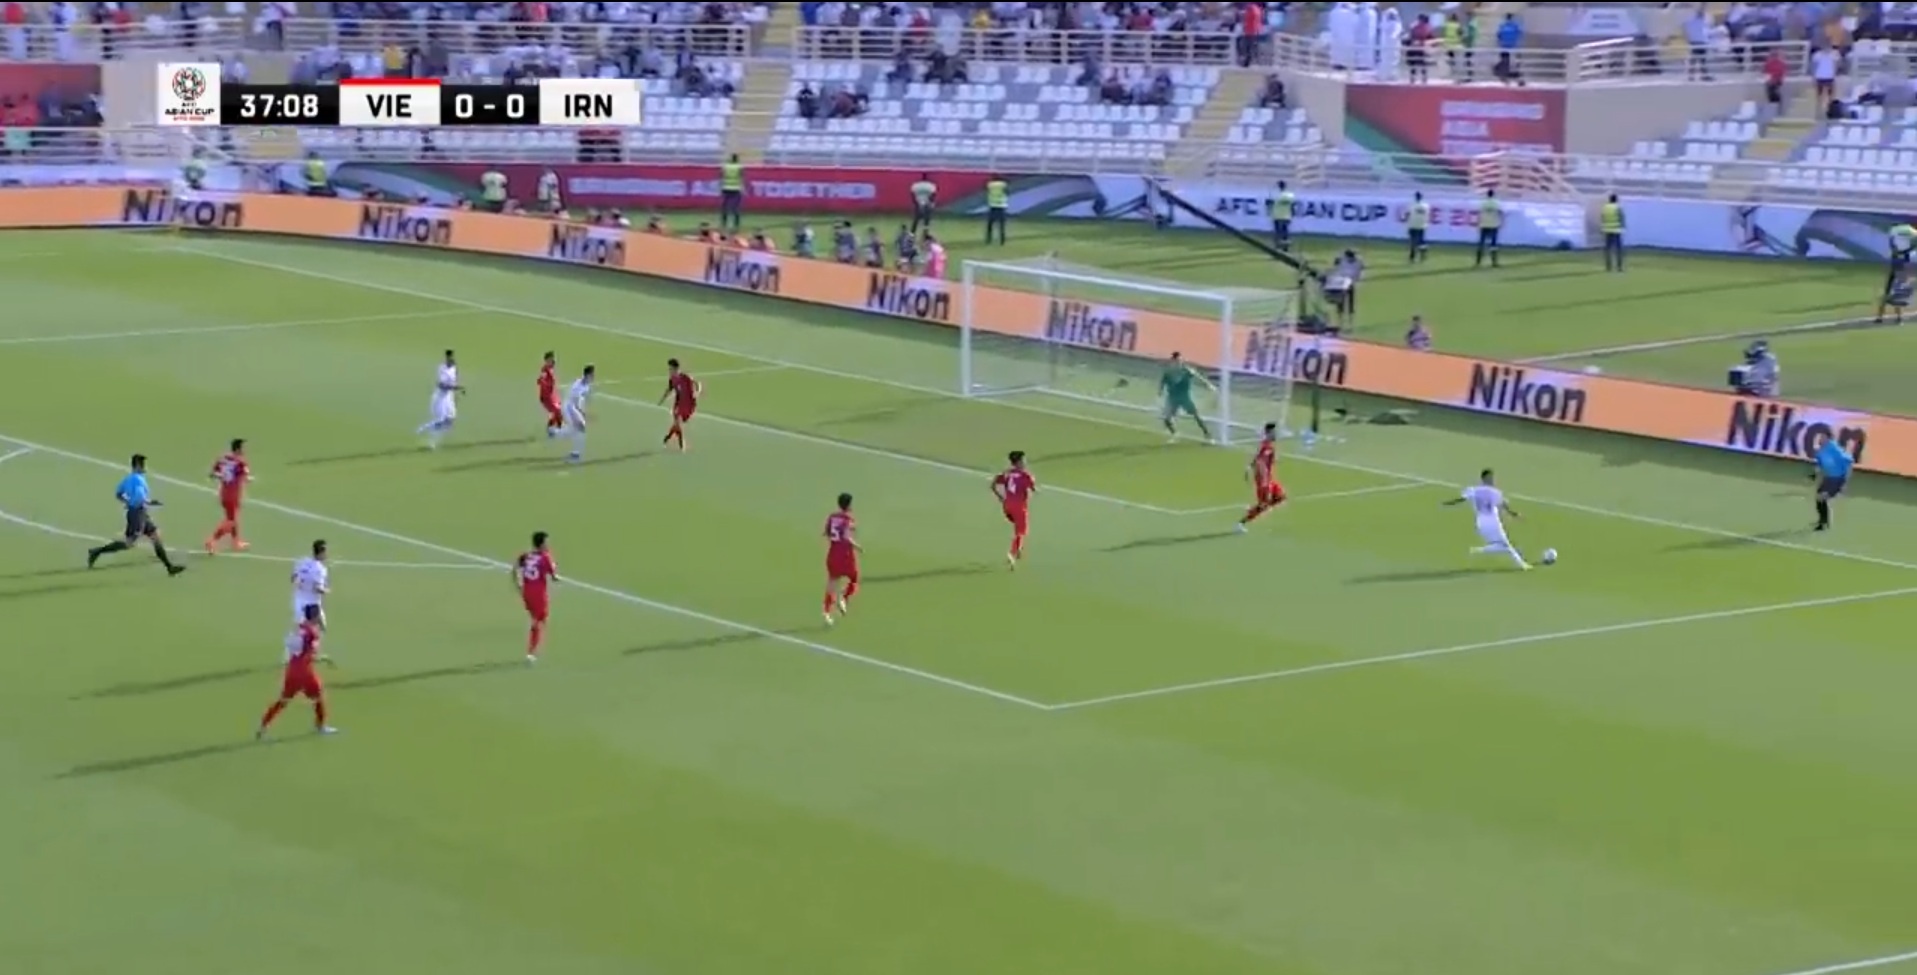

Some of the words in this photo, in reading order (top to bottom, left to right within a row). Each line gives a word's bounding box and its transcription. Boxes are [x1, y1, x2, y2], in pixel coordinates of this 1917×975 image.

[122, 189, 244, 227] Nikon
[359, 204, 453, 244] Nikon
[1214, 197, 1257, 215] AFC
[1341, 203, 1387, 221] CUP
[704, 248, 781, 294] Nikon
[867, 272, 951, 320] Nikon
[1045, 300, 1138, 351] Nikon
[1466, 363, 1587, 422] Nikon
[1726, 400, 1867, 464] Nikon
